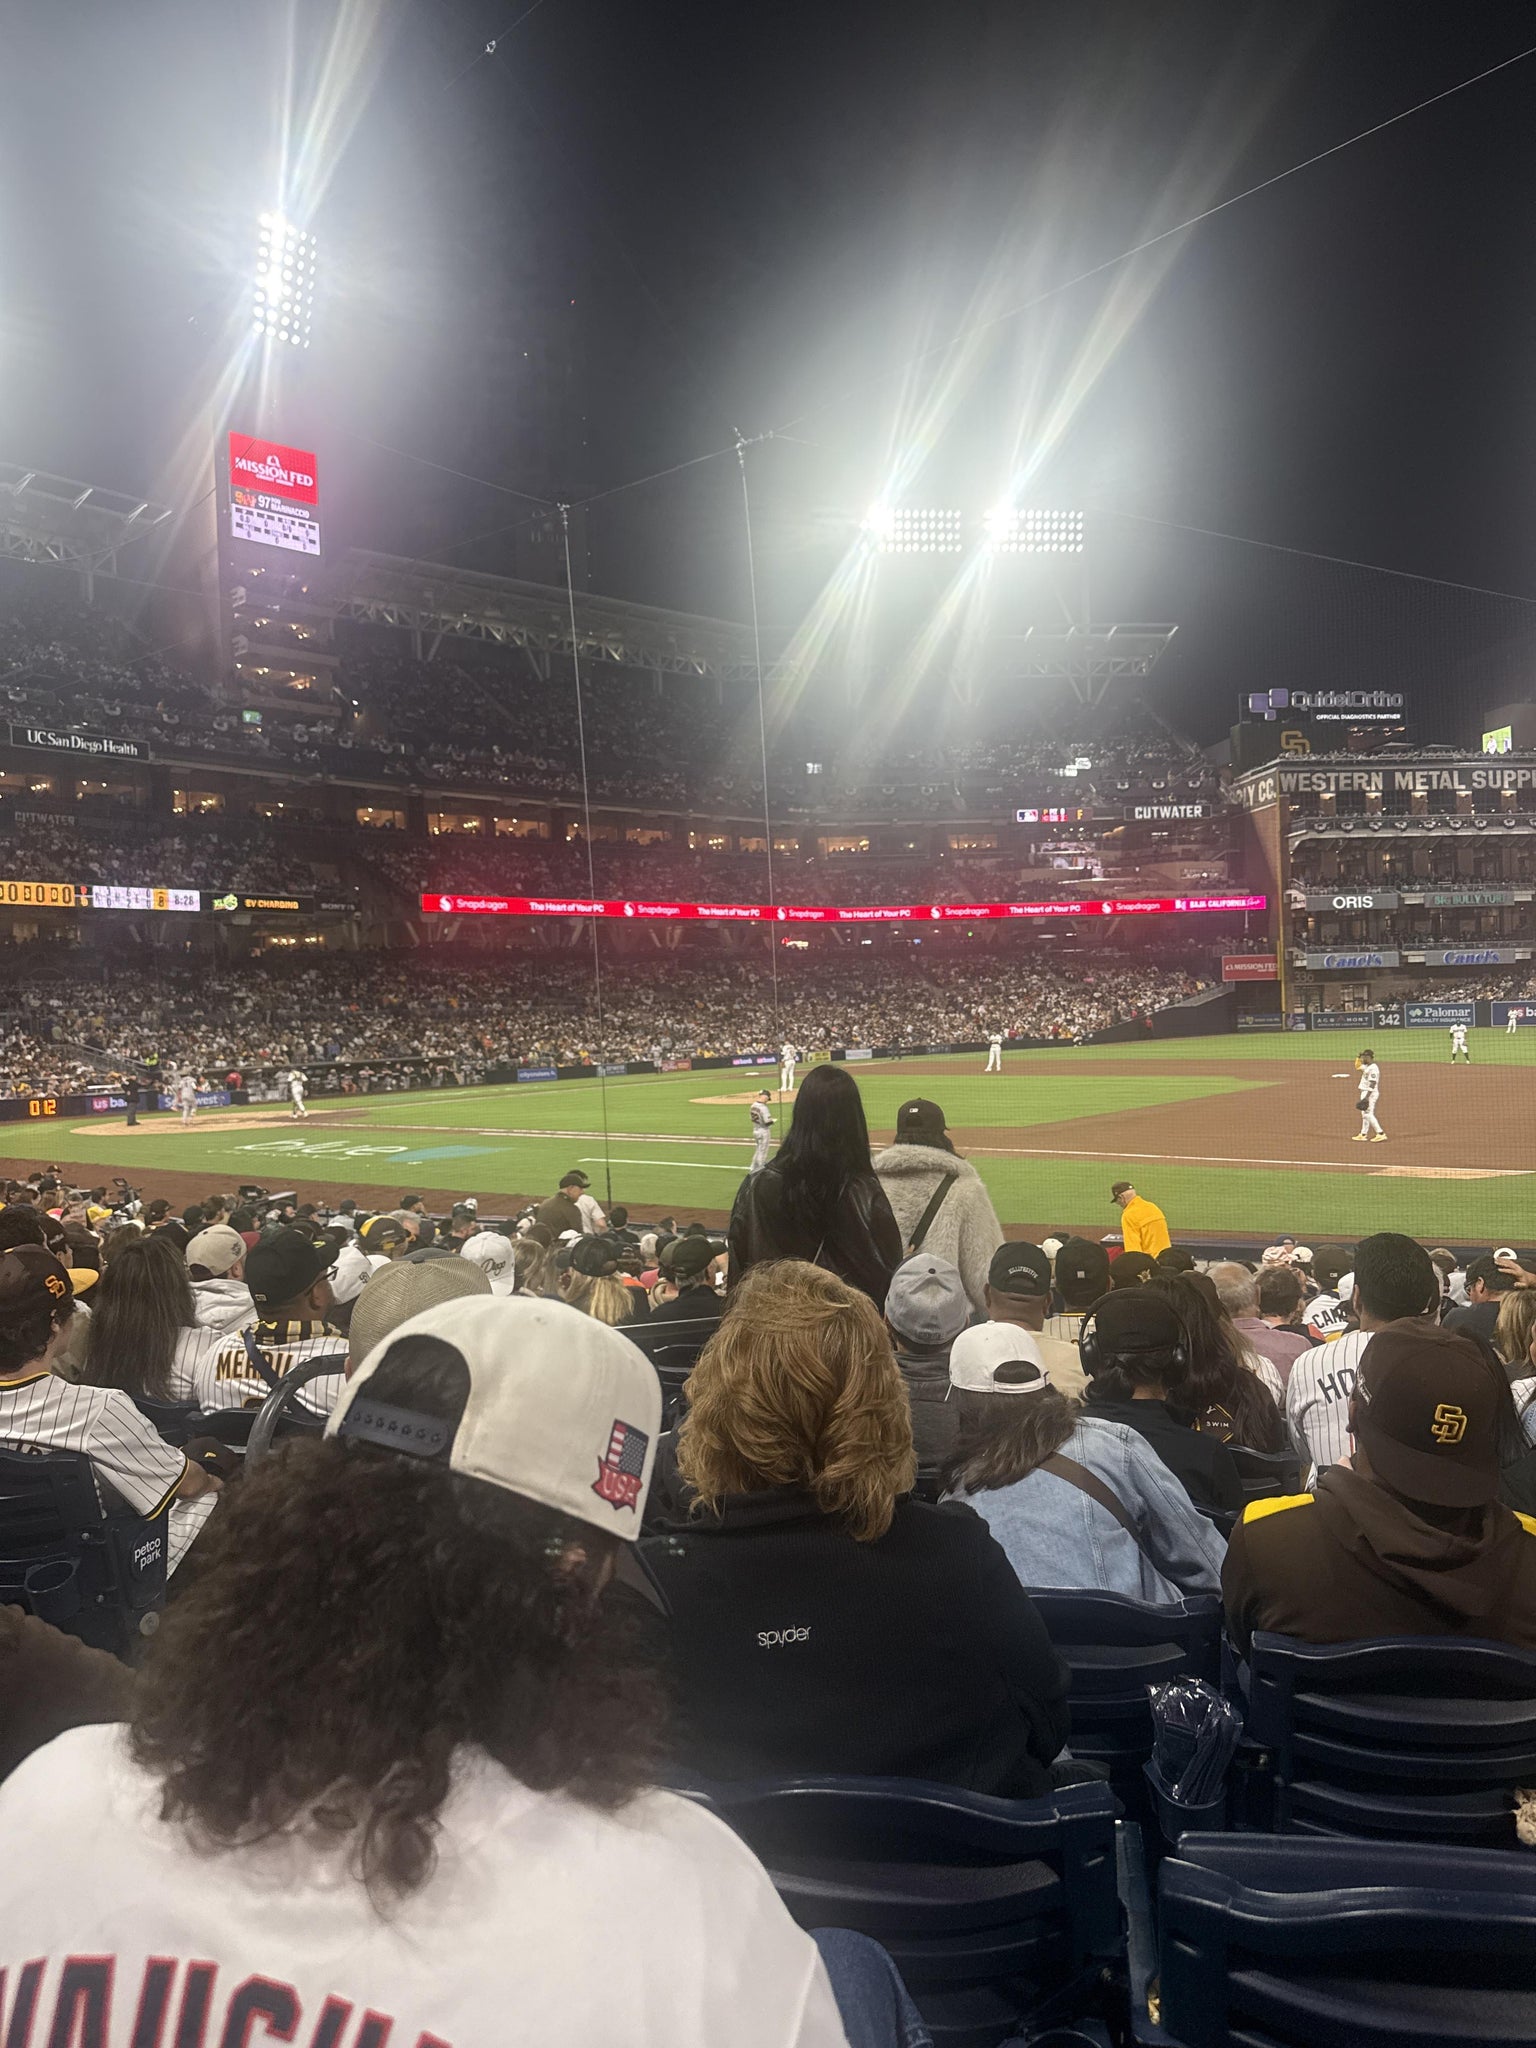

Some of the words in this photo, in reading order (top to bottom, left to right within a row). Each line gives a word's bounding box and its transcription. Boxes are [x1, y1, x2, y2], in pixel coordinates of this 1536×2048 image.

[235, 457, 288, 482] MISSION
[290, 471, 314, 488] FED
[258, 494, 271, 509] 97
[27, 730, 47, 745] UC
[47, 732, 70, 747] San
[70, 735, 103, 753] Diego
[103, 739, 138, 757] Health
[1280, 771, 1383, 792] WESTERN
[1394, 770, 1466, 790] METAL
[1134, 805, 1203, 819] CUTWATER
[174, 895, 195, 906] 8:28
[457, 898, 508, 911] Snapdragon
[1116, 901, 1160, 911] Snapdragon
[1208, 899, 1246, 908] CALIFORNIA
[1332, 895, 1374, 909] ORIS
[530, 902, 546, 911] The
[546, 902, 567, 912] Heart
[567, 903, 576, 912] of
[576, 903, 592, 913] Your
[593, 904, 605, 913] PC
[638, 905, 680, 917] Snapdragon
[697, 907, 709, 915] The
[710, 907, 729, 916] Heart
[736, 908, 750, 917] Your
[750, 909, 760, 917] PC
[945, 906, 990, 917] Snapdragon
[1023, 906, 1044, 914] Heart
[1052, 905, 1069, 913] Your
[1069, 904, 1081, 912] PC
[789, 909, 824, 919] Snapdragon
[839, 911, 852, 919] The
[853, 910, 873, 919] Heart
[874, 910, 882, 918] of
[882, 909, 899, 918] Your
[900, 909, 911, 917] PC
[1233, 963, 1263, 971] MISSION
[1424, 1007, 1471, 1018] Palomar
[1378, 1014, 1401, 1026] 342
[93, 1099, 108, 1109] us
[110, 1097, 128, 1108] ba
[165, 1095, 218, 1108] Sowest
[45, 1274, 67, 1299] SD
[1431, 1403, 1467, 1443] SD
[134, 1537, 161, 1563] petco
[140, 1548, 161, 1571] park
[758, 1623, 812, 1649] spyder
